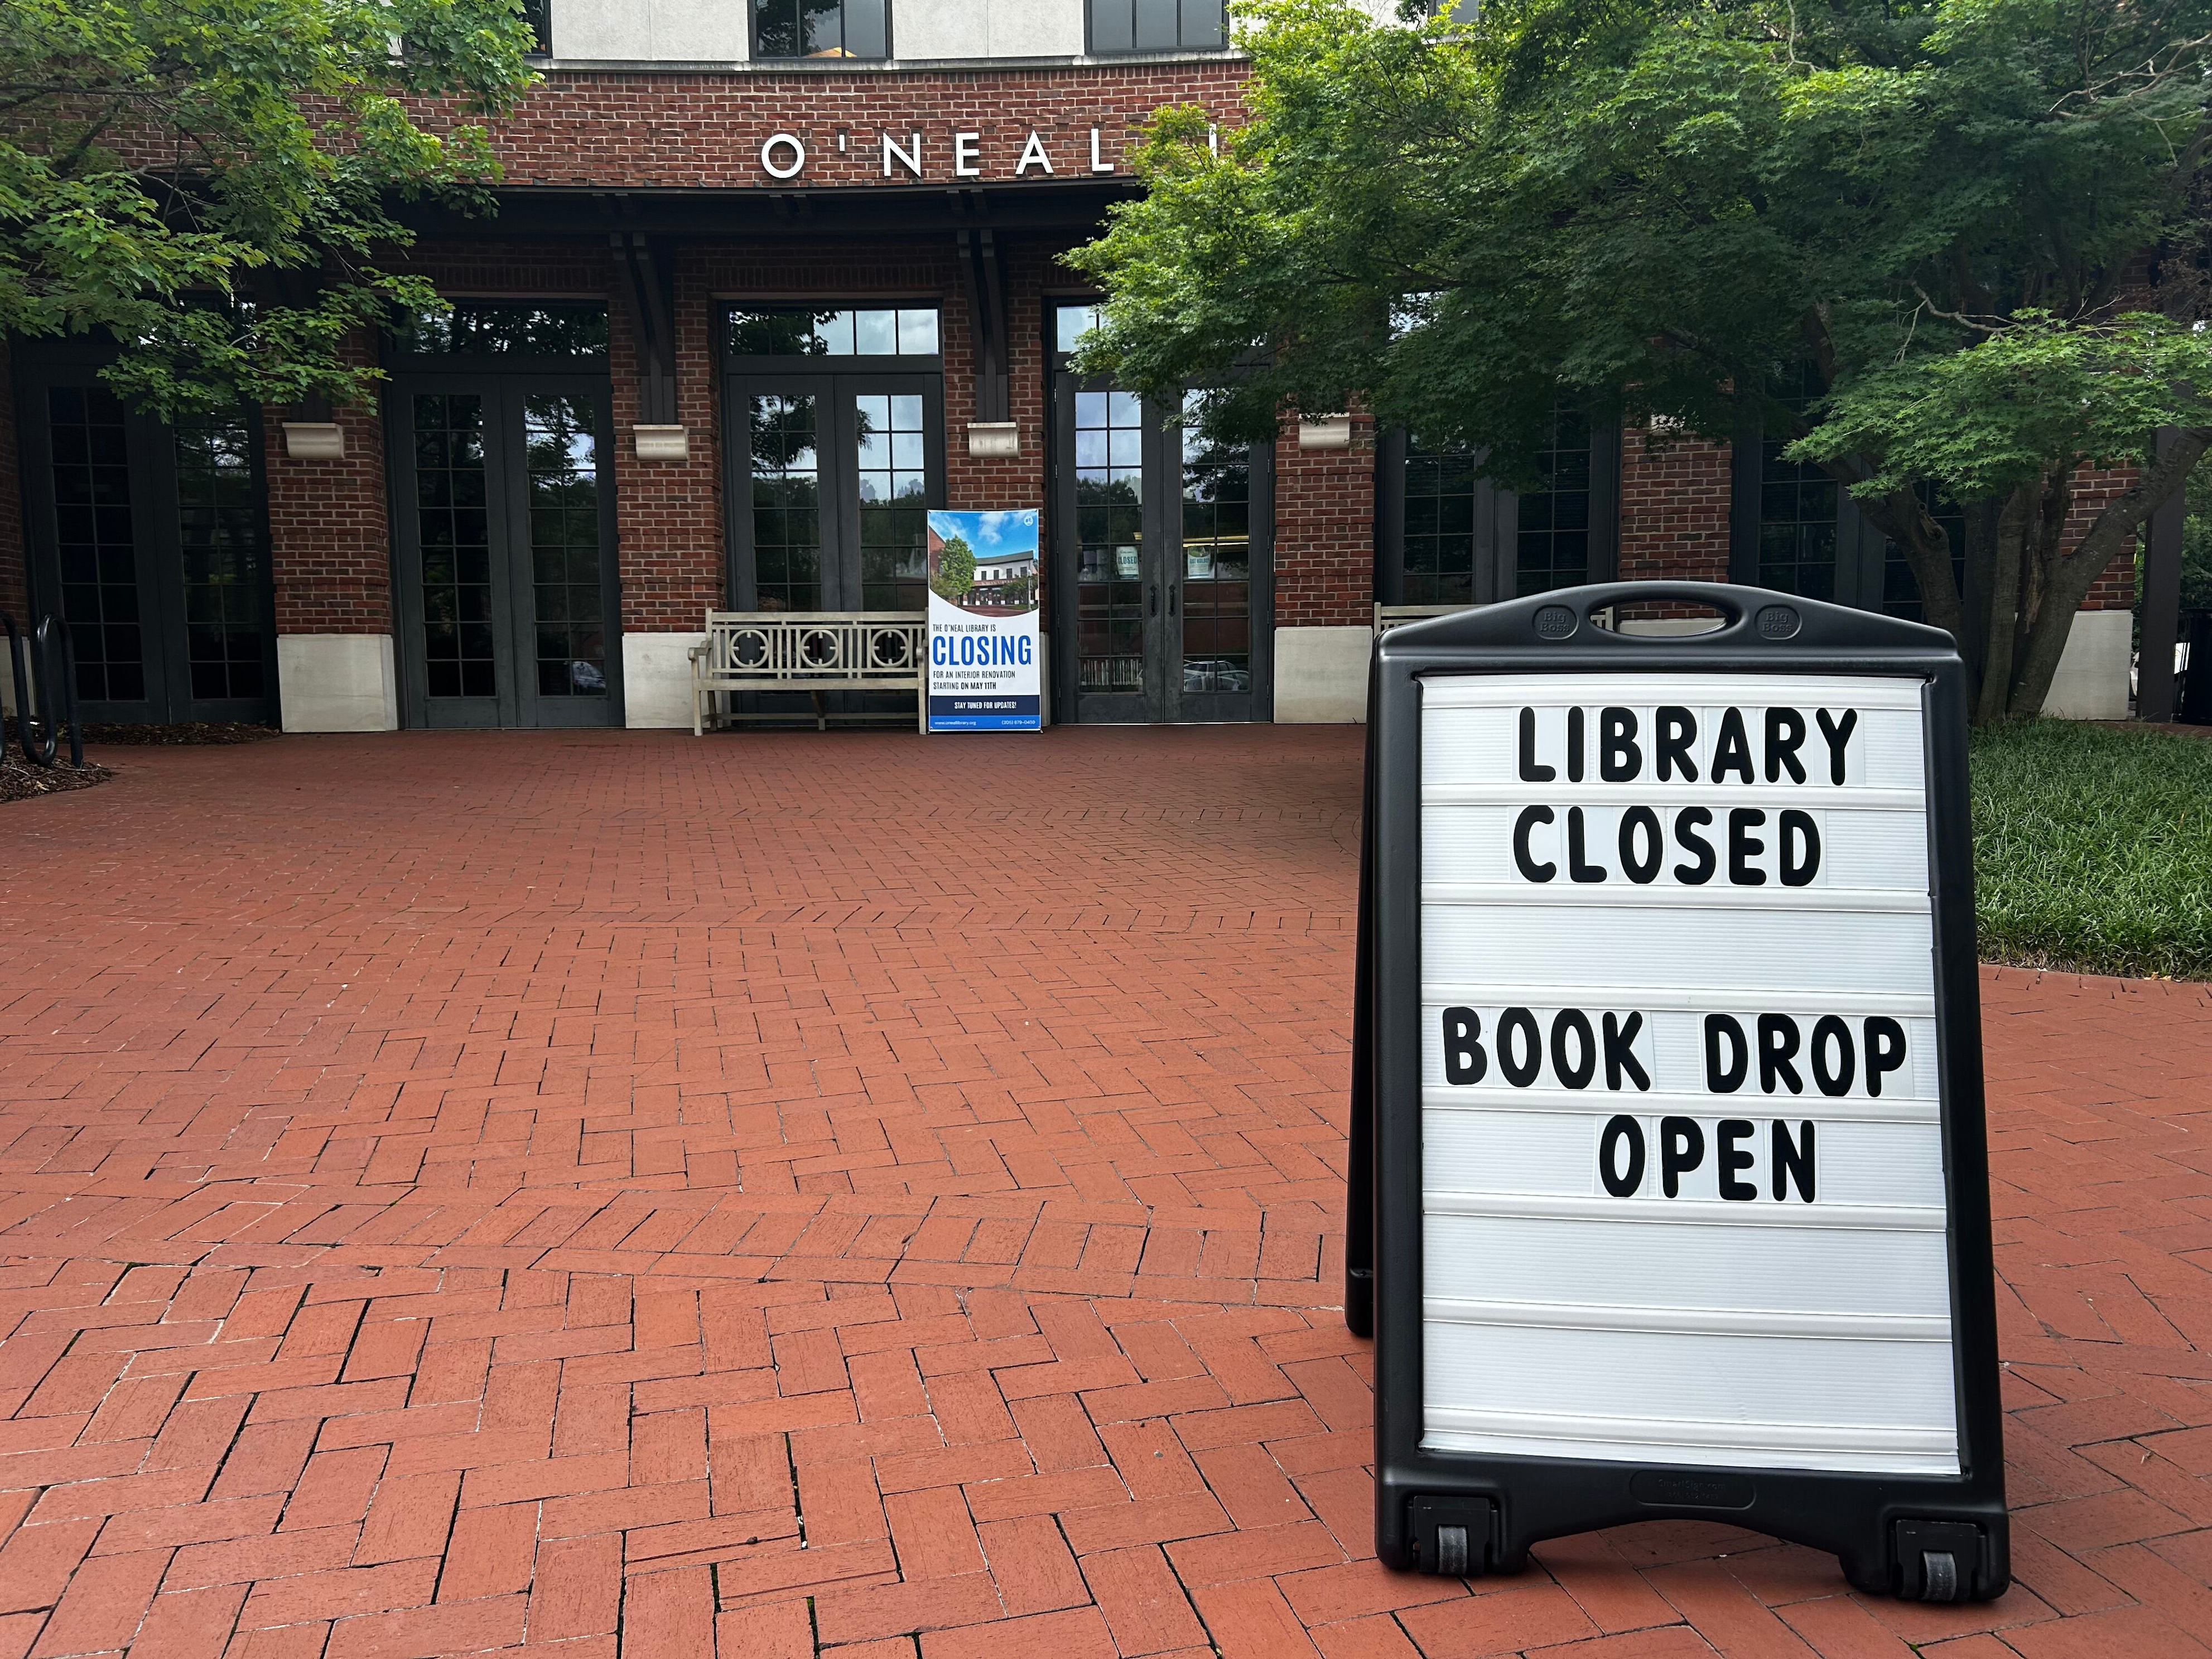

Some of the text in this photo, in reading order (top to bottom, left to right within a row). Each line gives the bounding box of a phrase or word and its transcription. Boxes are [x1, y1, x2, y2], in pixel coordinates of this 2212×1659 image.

[761, 128, 1114, 179] O'NEAL
[1118, 556, 1138, 565] CLOSED
[1543, 611, 1567, 623] Big
[1765, 611, 1789, 623] Big
[933, 624, 942, 632] THE
[944, 624, 964, 632] O'NEAL
[1539, 622, 1570, 632] Boss
[1761, 621, 1793, 633] Boss
[933, 635, 1032, 665] CLOSING
[1519, 706, 1857, 786] LIBRARY
[1513, 805, 1821, 886] CLOSED
[1442, 1006, 1907, 1098] BOOK DROP
[1599, 1115, 1816, 1203] OPEN
[1658, 1478, 1727, 1491] SmartSign.com
